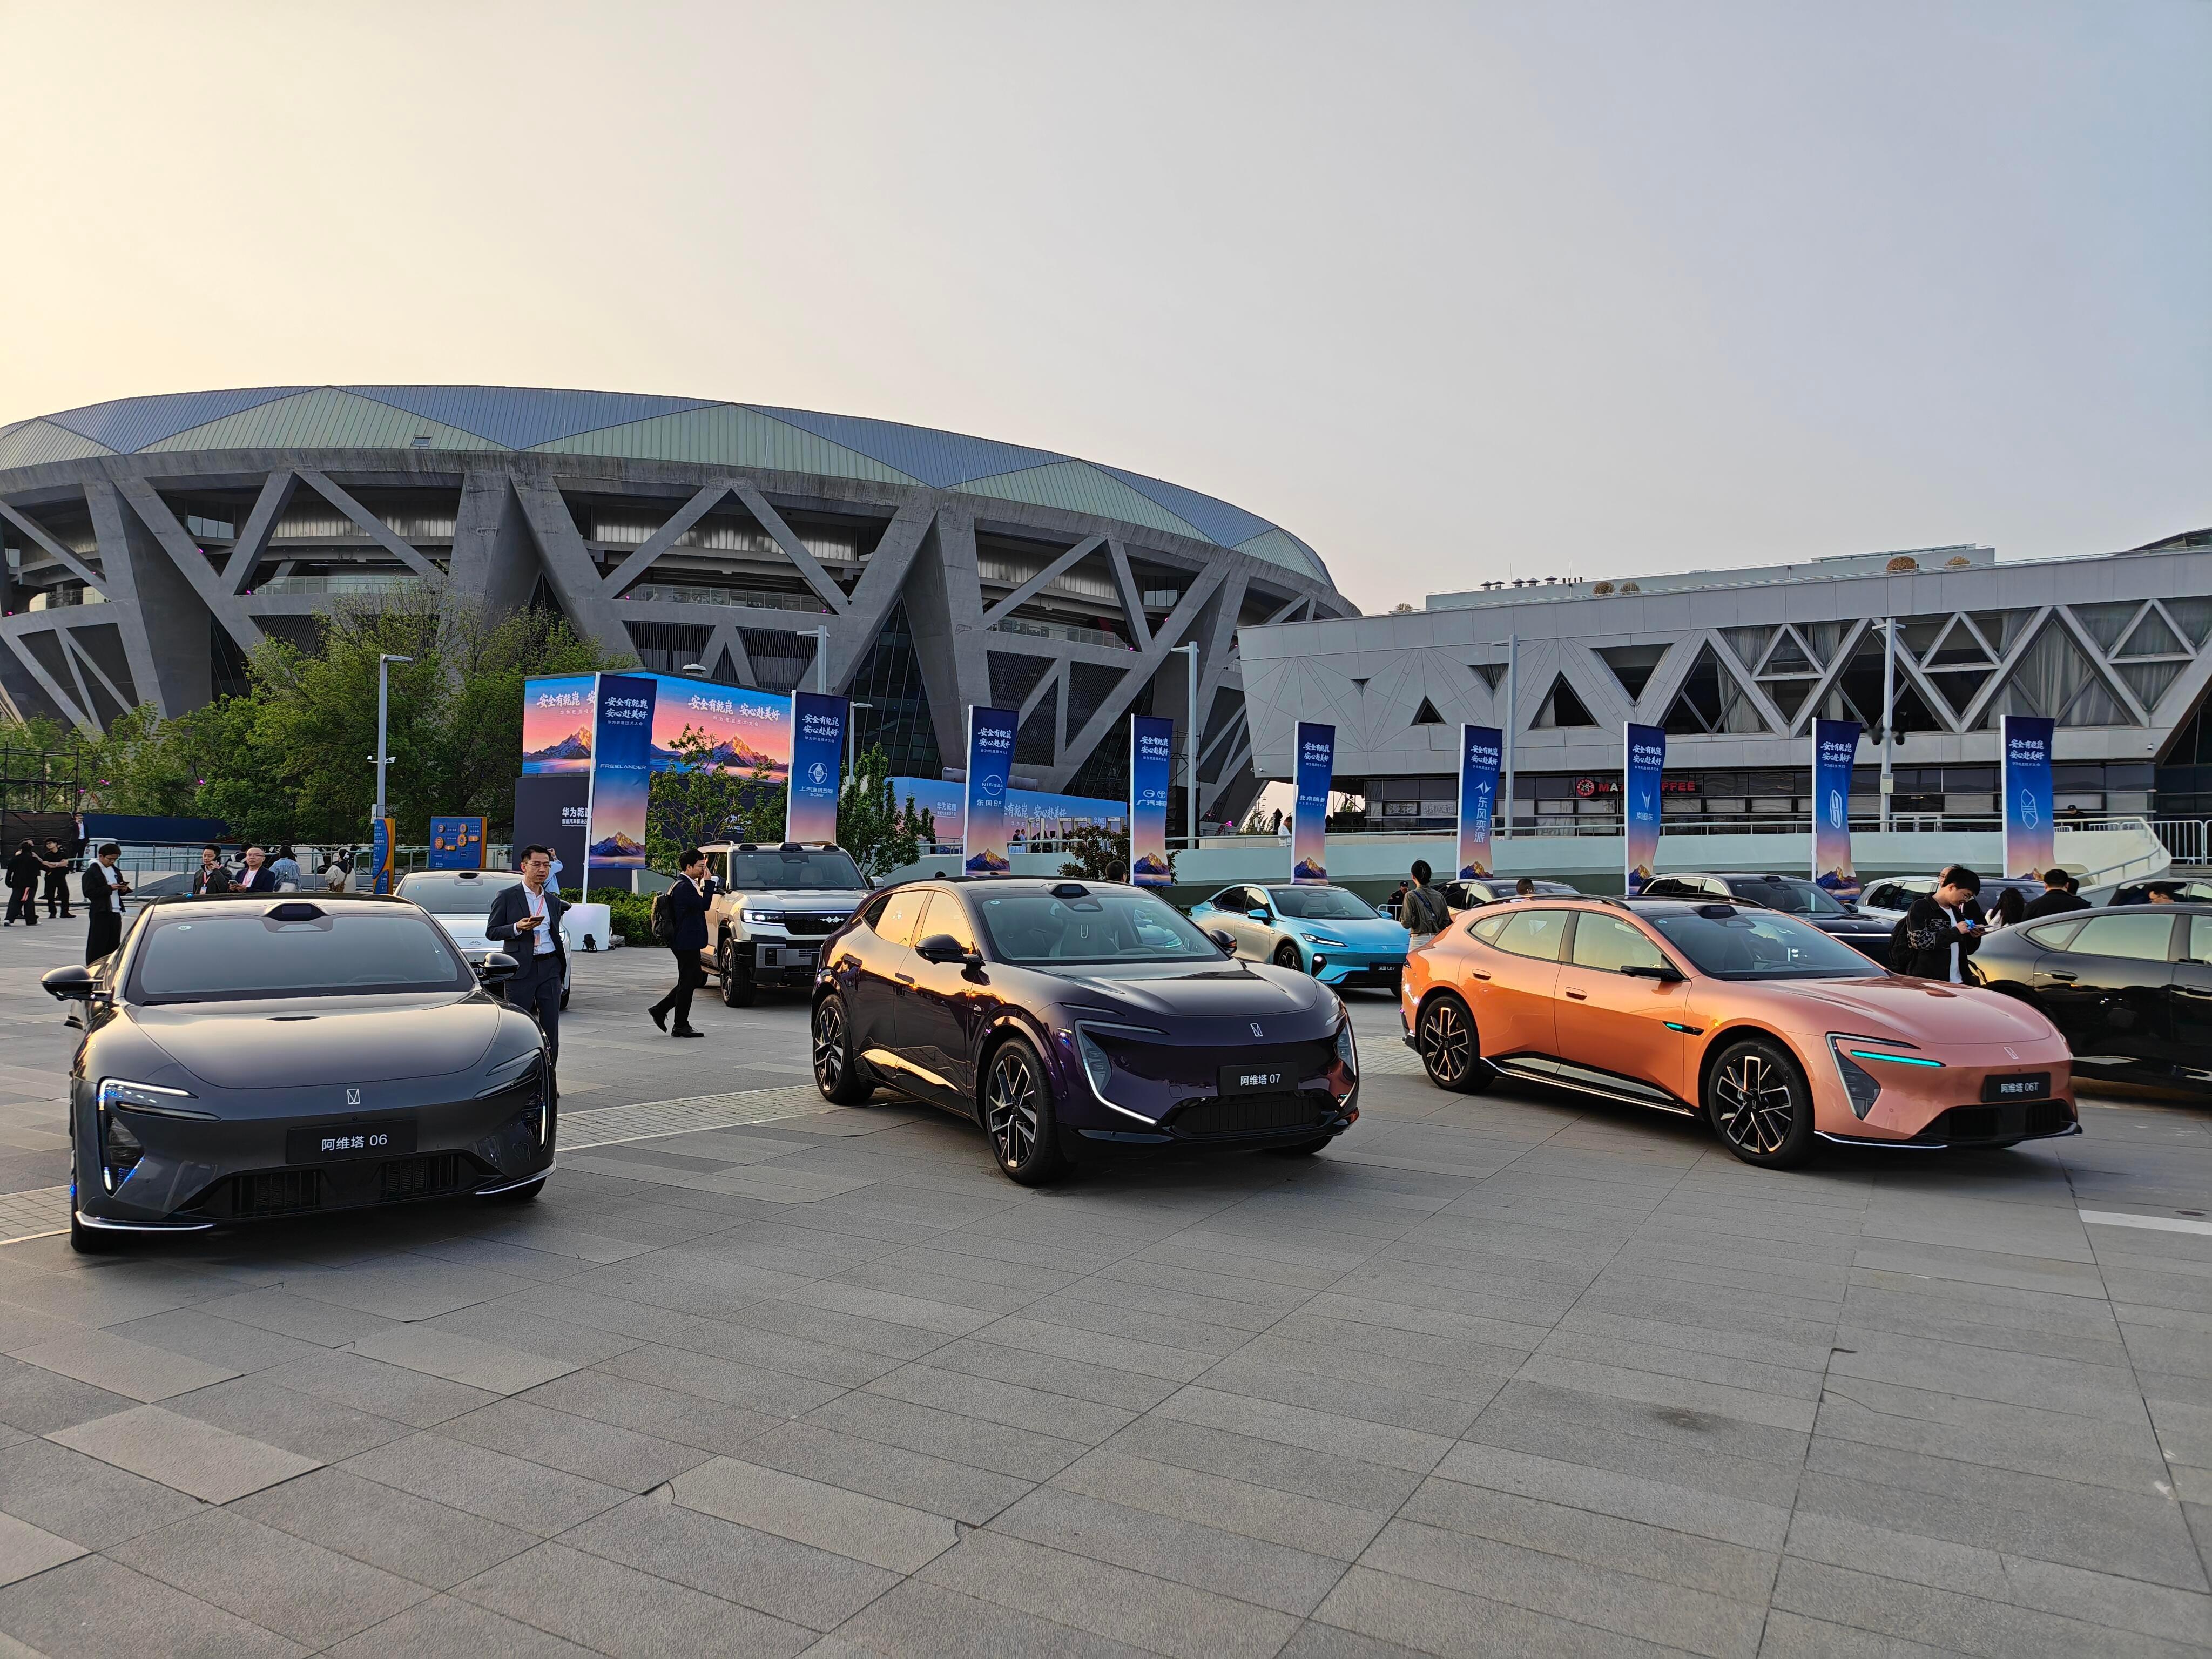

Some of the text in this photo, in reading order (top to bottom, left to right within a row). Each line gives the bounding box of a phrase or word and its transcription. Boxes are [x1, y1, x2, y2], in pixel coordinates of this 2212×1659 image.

[605, 696, 648, 709] 安全有乾崑
[605, 709, 648, 719] 安心赴美好
[739, 703, 781, 721] 安心赴美好
[802, 725, 839, 737] 安心赴美好
[1599, 781, 1696, 792] MA FFEE
[1004, 802, 1028, 818] 有乾崑
[1474, 795, 1488, 844] 东风奕派
[1240, 1074, 1281, 1087] 阿维塔 07
[2025, 1082, 2039, 1091] 06T
[321, 1134, 387, 1151] 阿维塔 06
